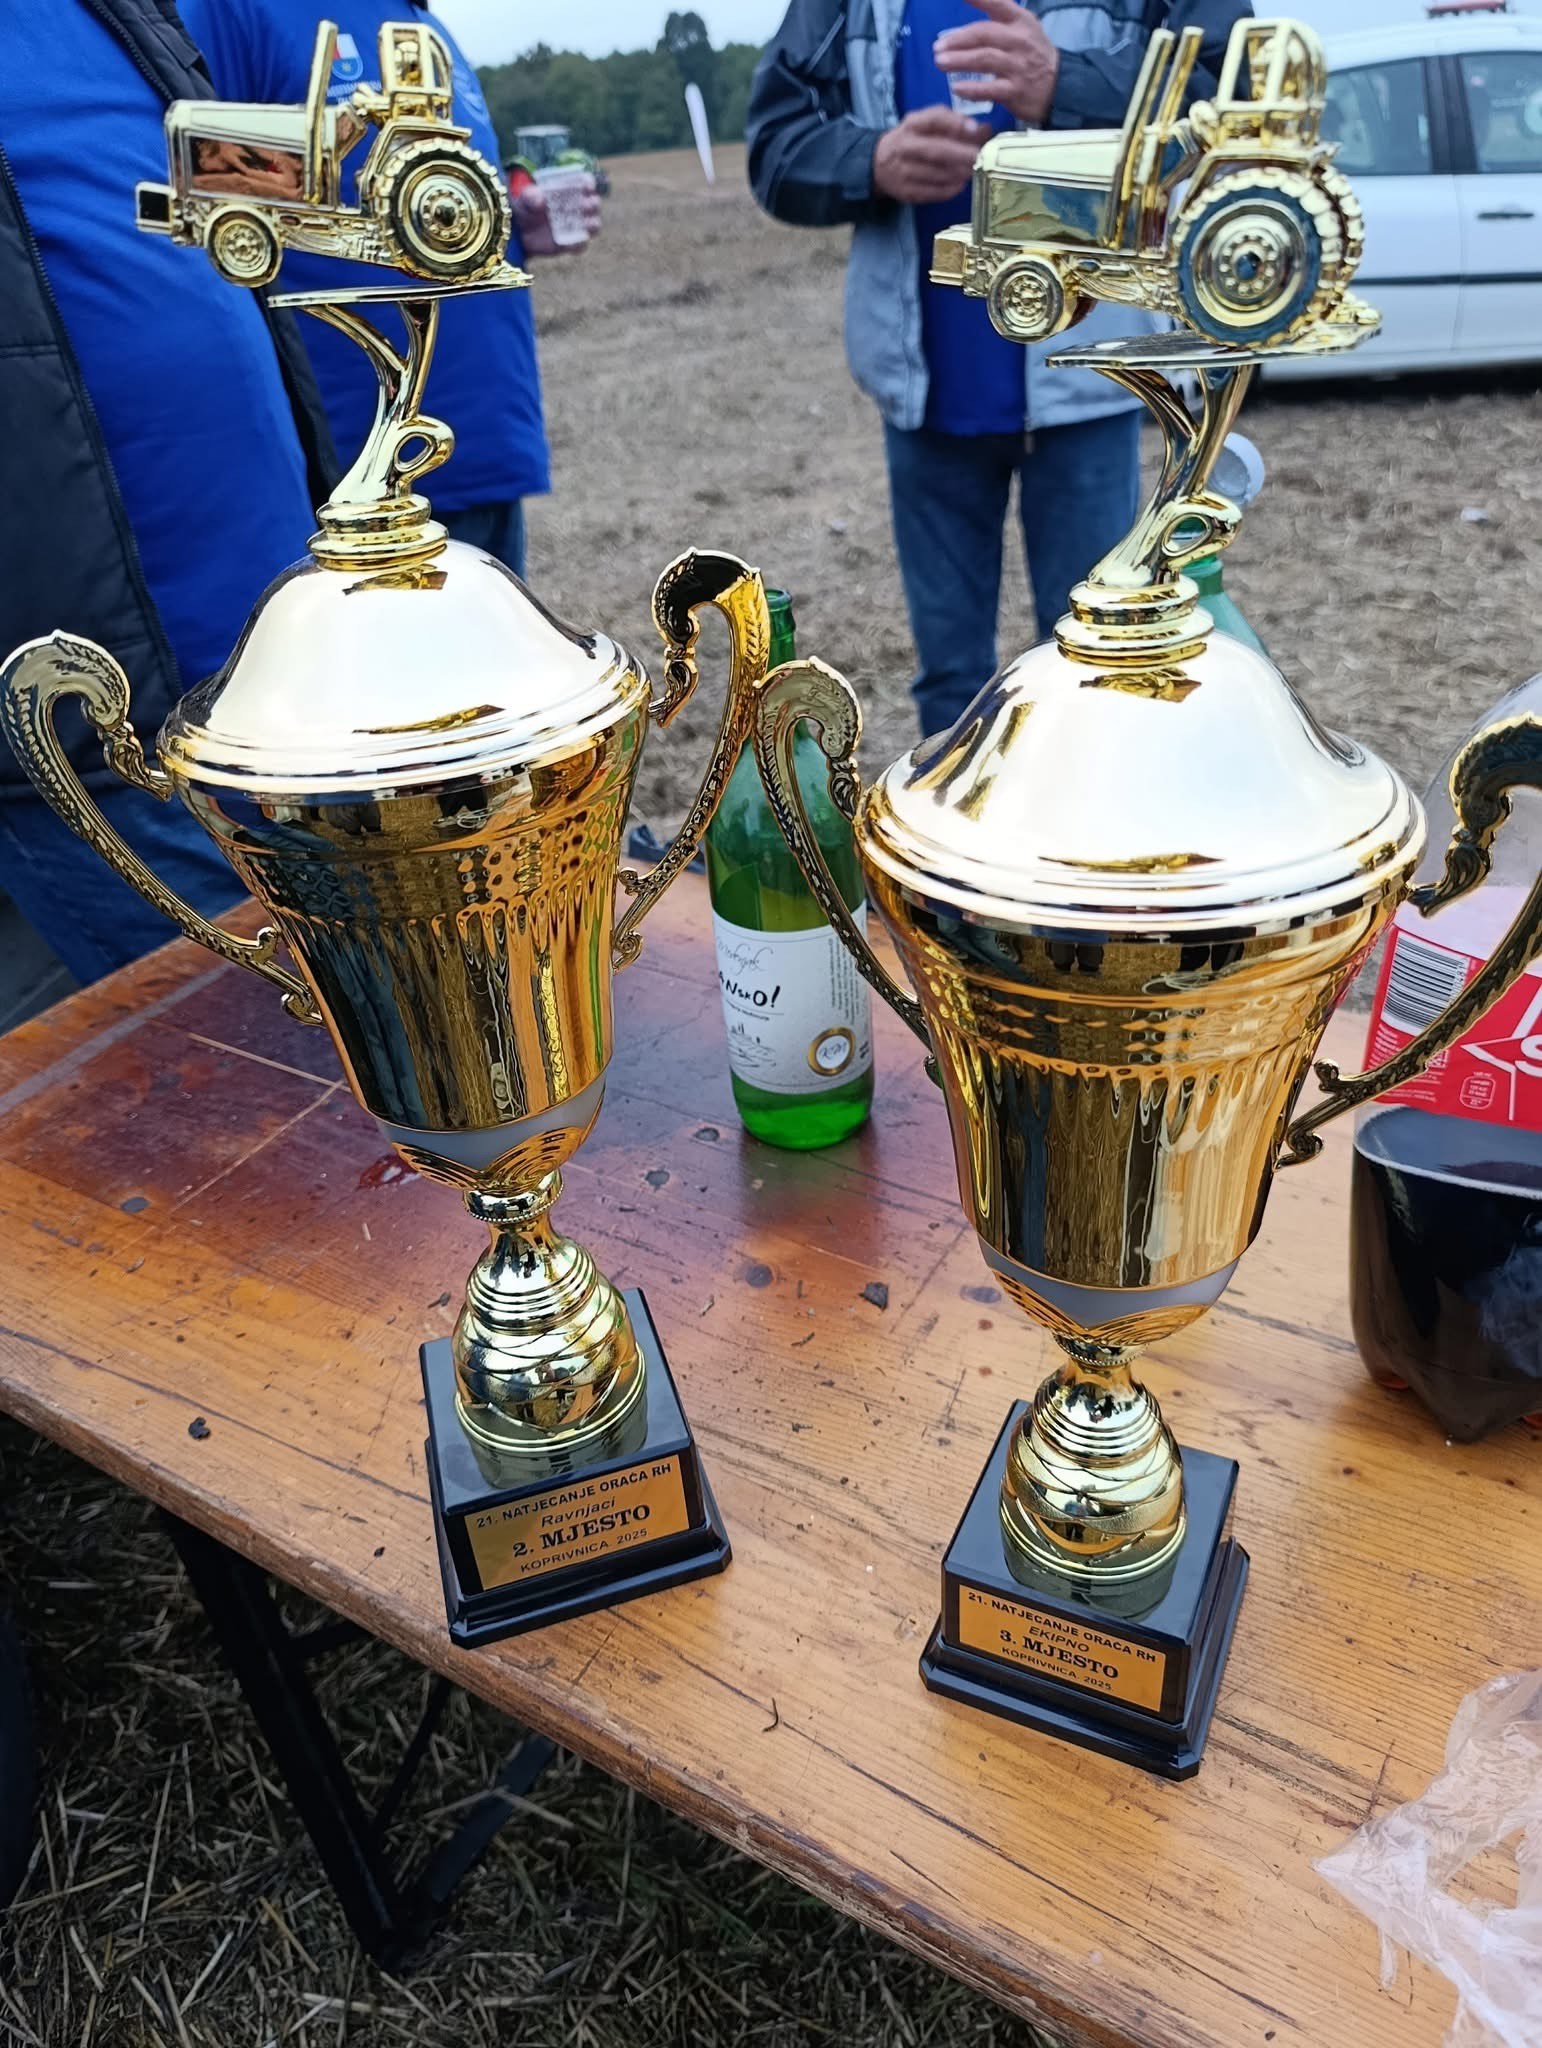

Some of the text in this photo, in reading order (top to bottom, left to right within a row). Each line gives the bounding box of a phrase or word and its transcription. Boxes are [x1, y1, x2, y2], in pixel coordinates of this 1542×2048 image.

[477, 1515, 498, 1528] 21.
[503, 1485, 596, 1521] NATJECANJE
[652, 1463, 671, 1477] RH
[541, 1496, 616, 1527] Ravnjaci
[512, 1504, 650, 1557] 2. MJESTO
[520, 1528, 648, 1573] KOPRIVNICA 2025
[968, 1592, 987, 1605] 21.
[991, 1600, 1079, 1636] NATJECANJE
[1136, 1649, 1156, 1662] RH
[1029, 1626, 1089, 1652] EKIPNO
[1000, 1629, 1118, 1678] 3. MJESTO
